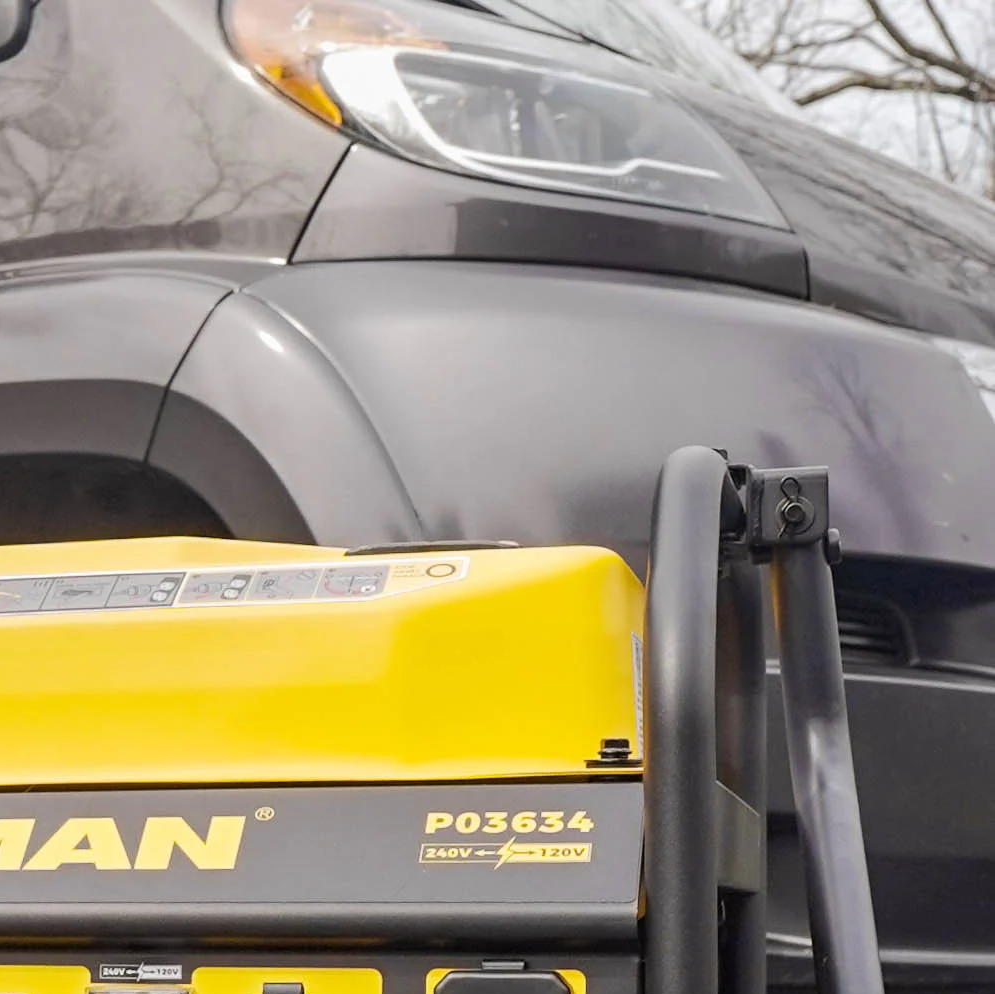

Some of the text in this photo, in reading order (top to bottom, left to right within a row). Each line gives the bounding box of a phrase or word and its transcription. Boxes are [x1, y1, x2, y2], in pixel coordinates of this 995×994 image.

[424, 810, 594, 834] P03634
[425, 847, 473, 859] 240V
[541, 847, 586, 858] 120V
[102, 967, 126, 976] 240V
